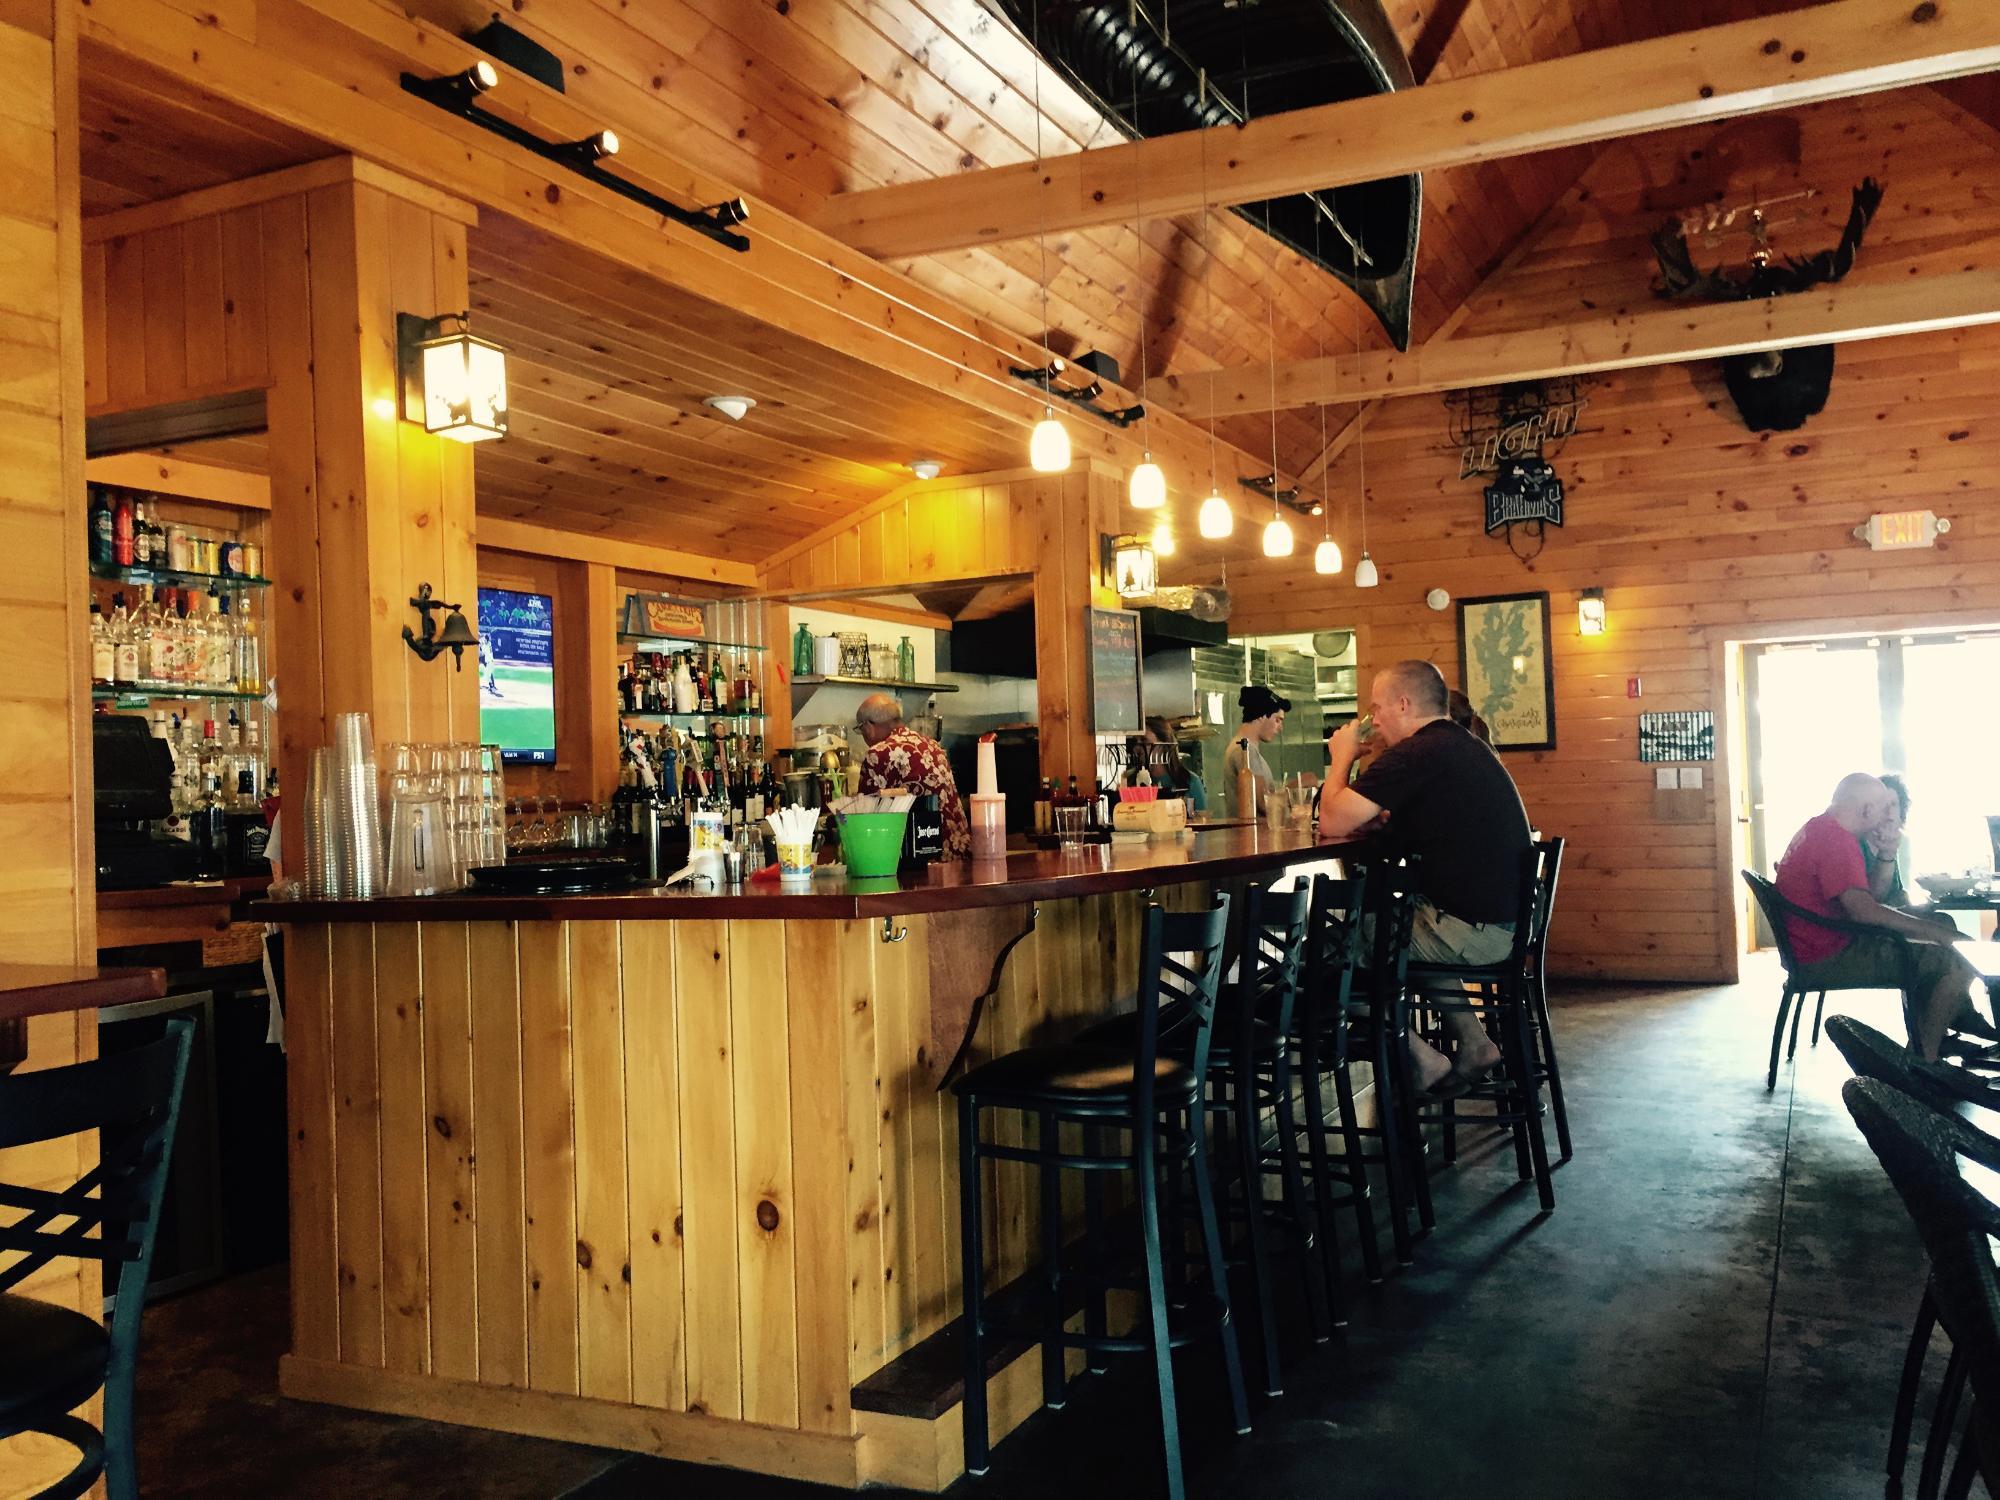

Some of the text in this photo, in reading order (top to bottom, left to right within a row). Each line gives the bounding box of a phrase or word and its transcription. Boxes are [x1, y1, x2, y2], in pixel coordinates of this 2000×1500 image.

[1459, 399, 1589, 480] LIGHT
[1881, 512, 1924, 545] EXIT
[533, 751, 545, 760] FS1
